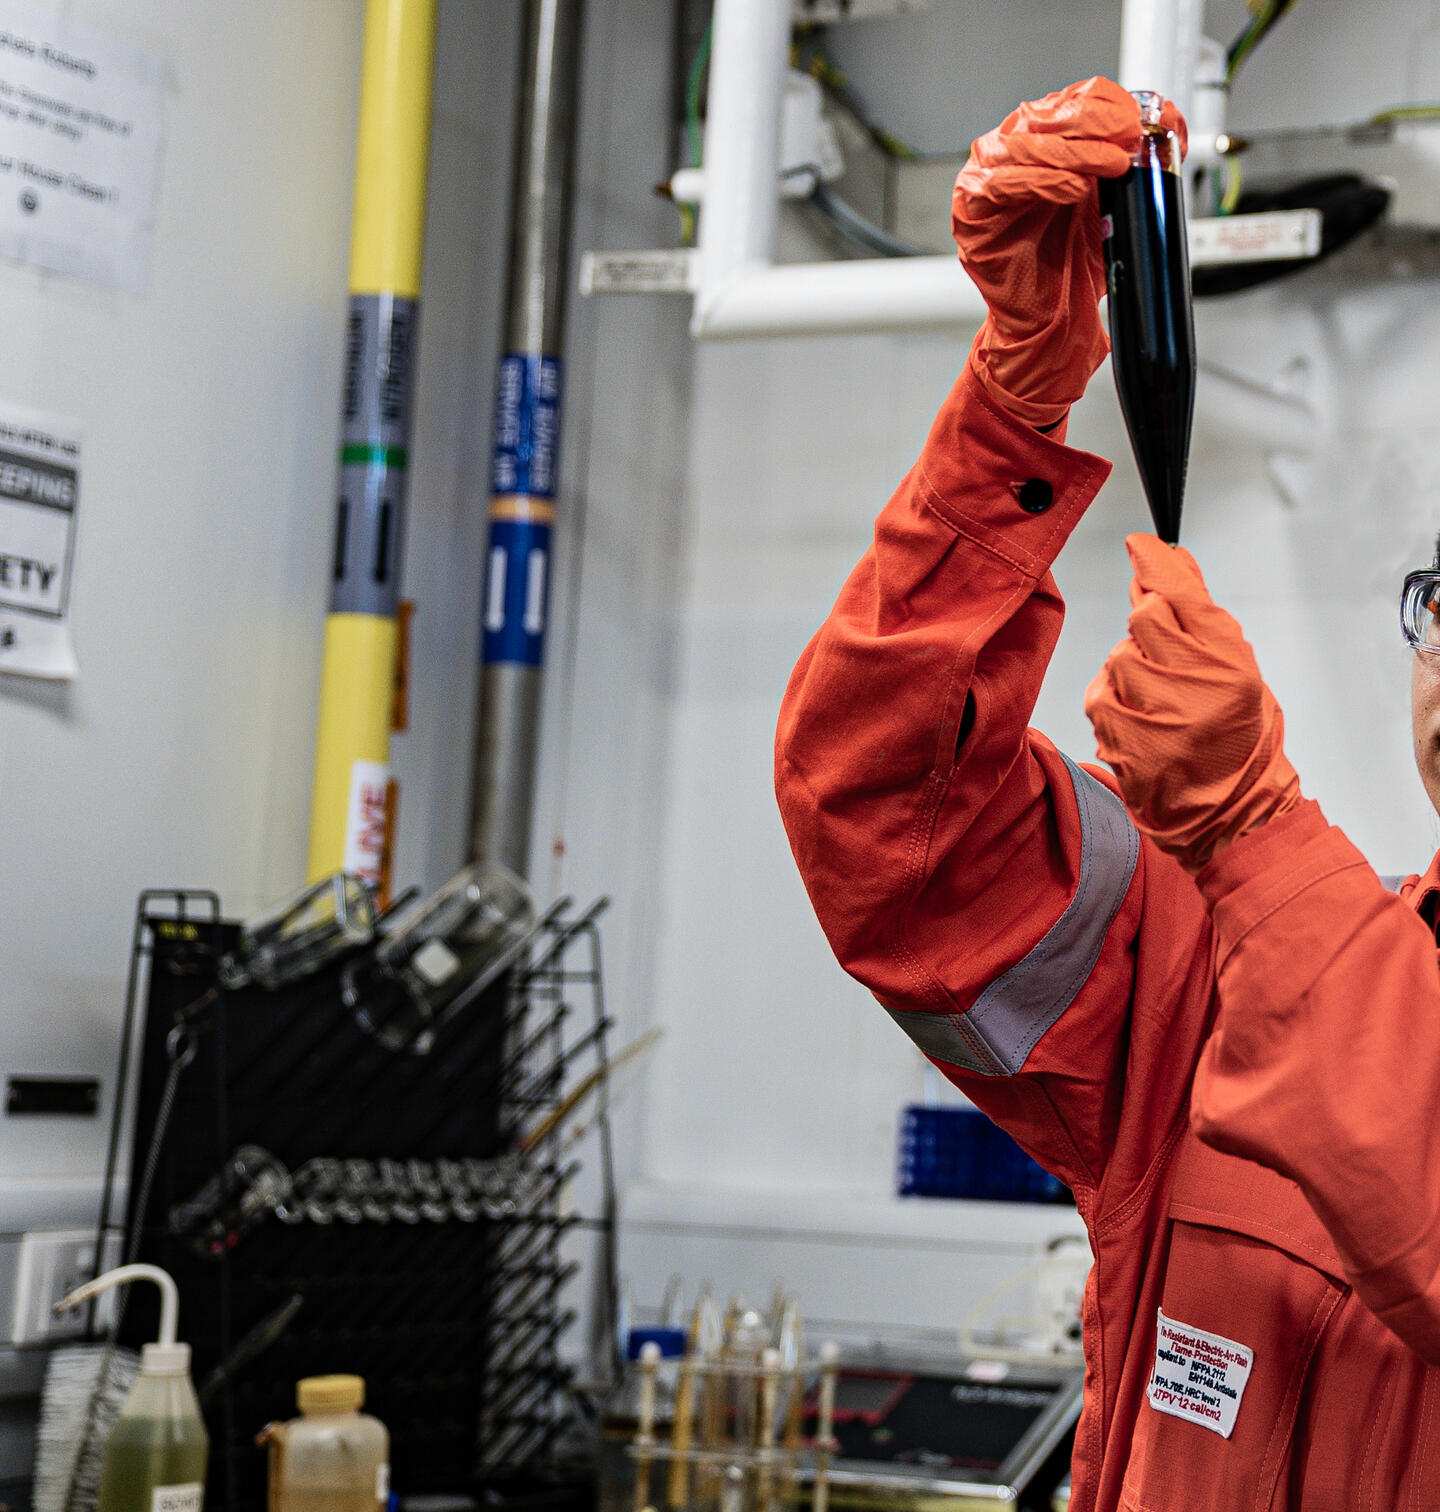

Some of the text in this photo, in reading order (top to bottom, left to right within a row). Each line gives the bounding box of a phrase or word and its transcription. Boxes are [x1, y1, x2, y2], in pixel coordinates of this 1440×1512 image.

[1190, 1360, 1211, 1376] NFPA
[1211, 1367, 1226, 1382] 2112
[1193, 1349, 1229, 1371] Protection
[1153, 1387, 1178, 1405] ATPV
[1177, 1395, 1189, 1410] 12
[1184, 1385, 1201, 1400] HRC
